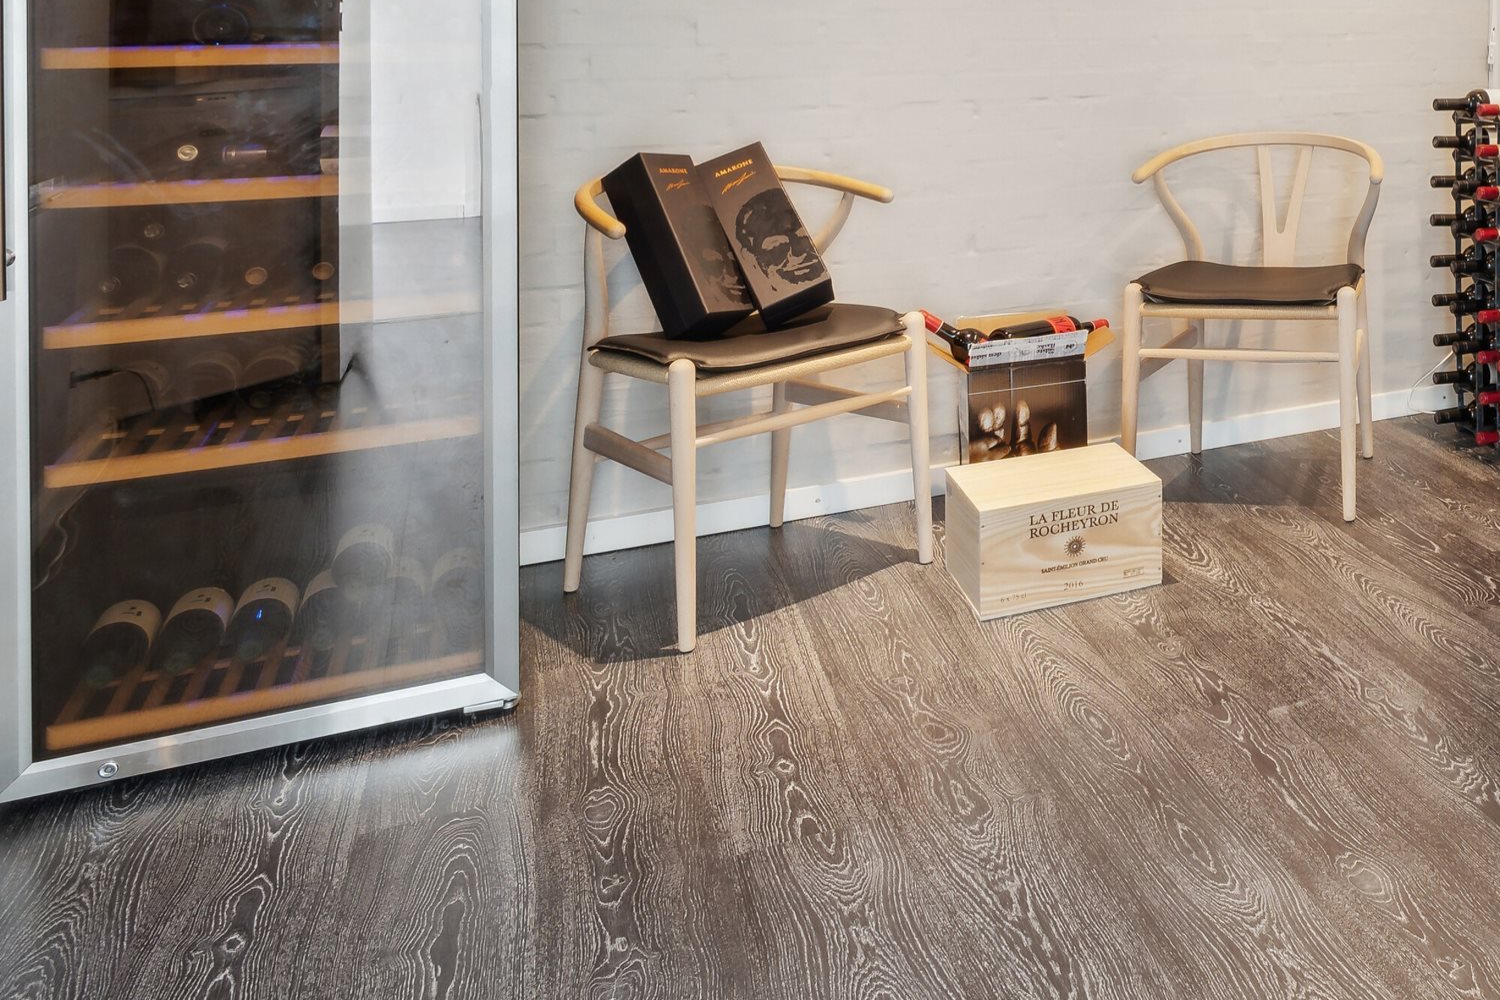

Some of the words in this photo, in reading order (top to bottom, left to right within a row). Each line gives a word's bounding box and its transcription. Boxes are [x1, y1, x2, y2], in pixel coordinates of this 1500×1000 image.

[715, 159, 754, 178] AMARONE
[1029, 514, 1047, 526] LA
[1051, 504, 1096, 522] FLEUR
[1101, 500, 1120, 513] DE
[1029, 513, 1120, 539] ROCHEYRON
[1063, 580, 1084, 592] 2016
